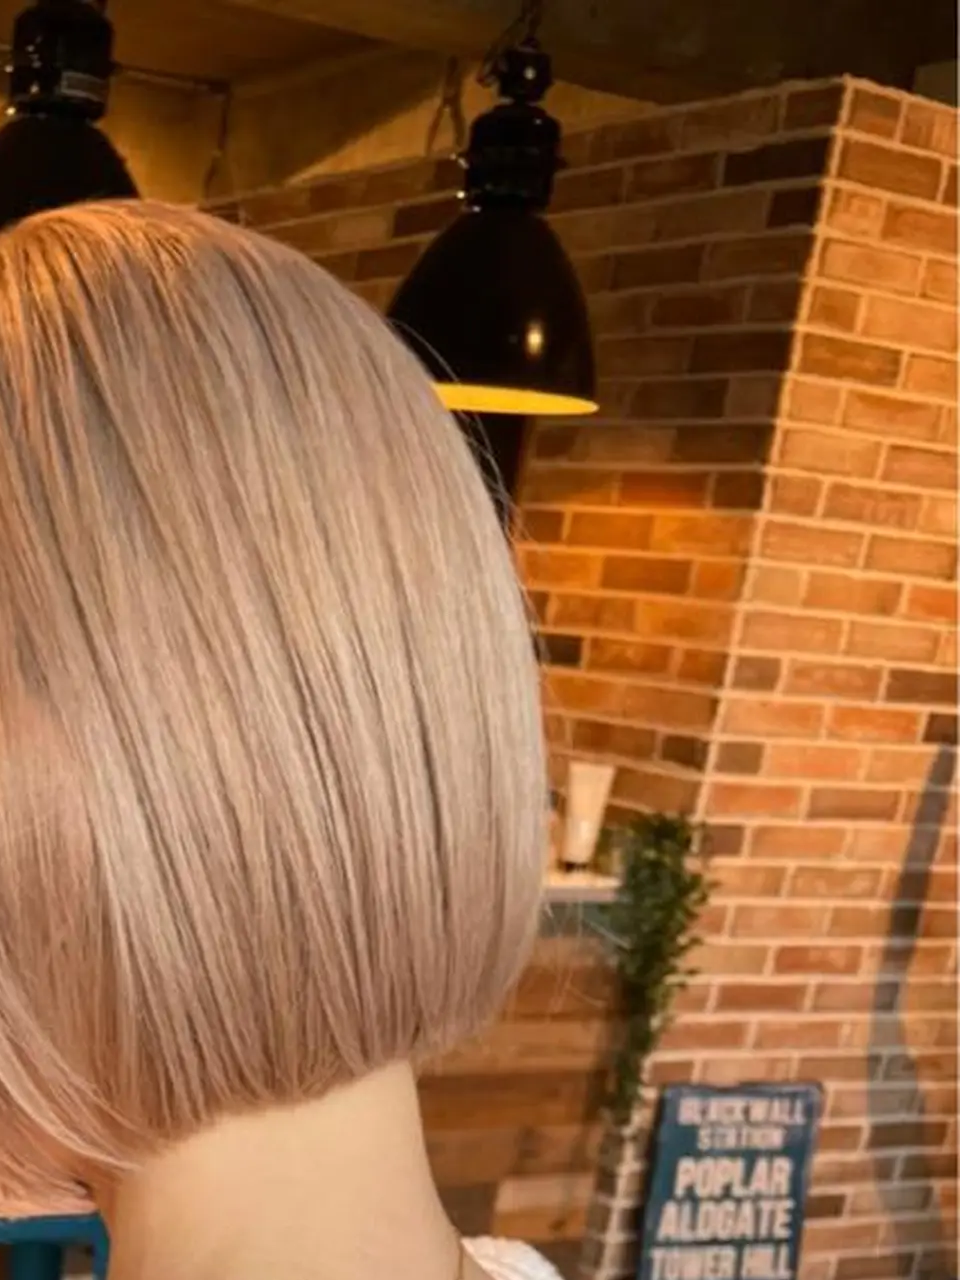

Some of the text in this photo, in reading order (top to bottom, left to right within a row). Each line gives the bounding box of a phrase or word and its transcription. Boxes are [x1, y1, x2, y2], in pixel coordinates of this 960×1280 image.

[674, 1155, 793, 1199] POPLAR
[656, 1198, 796, 1242] ALDGATE
[741, 1242, 793, 1280] HILL
